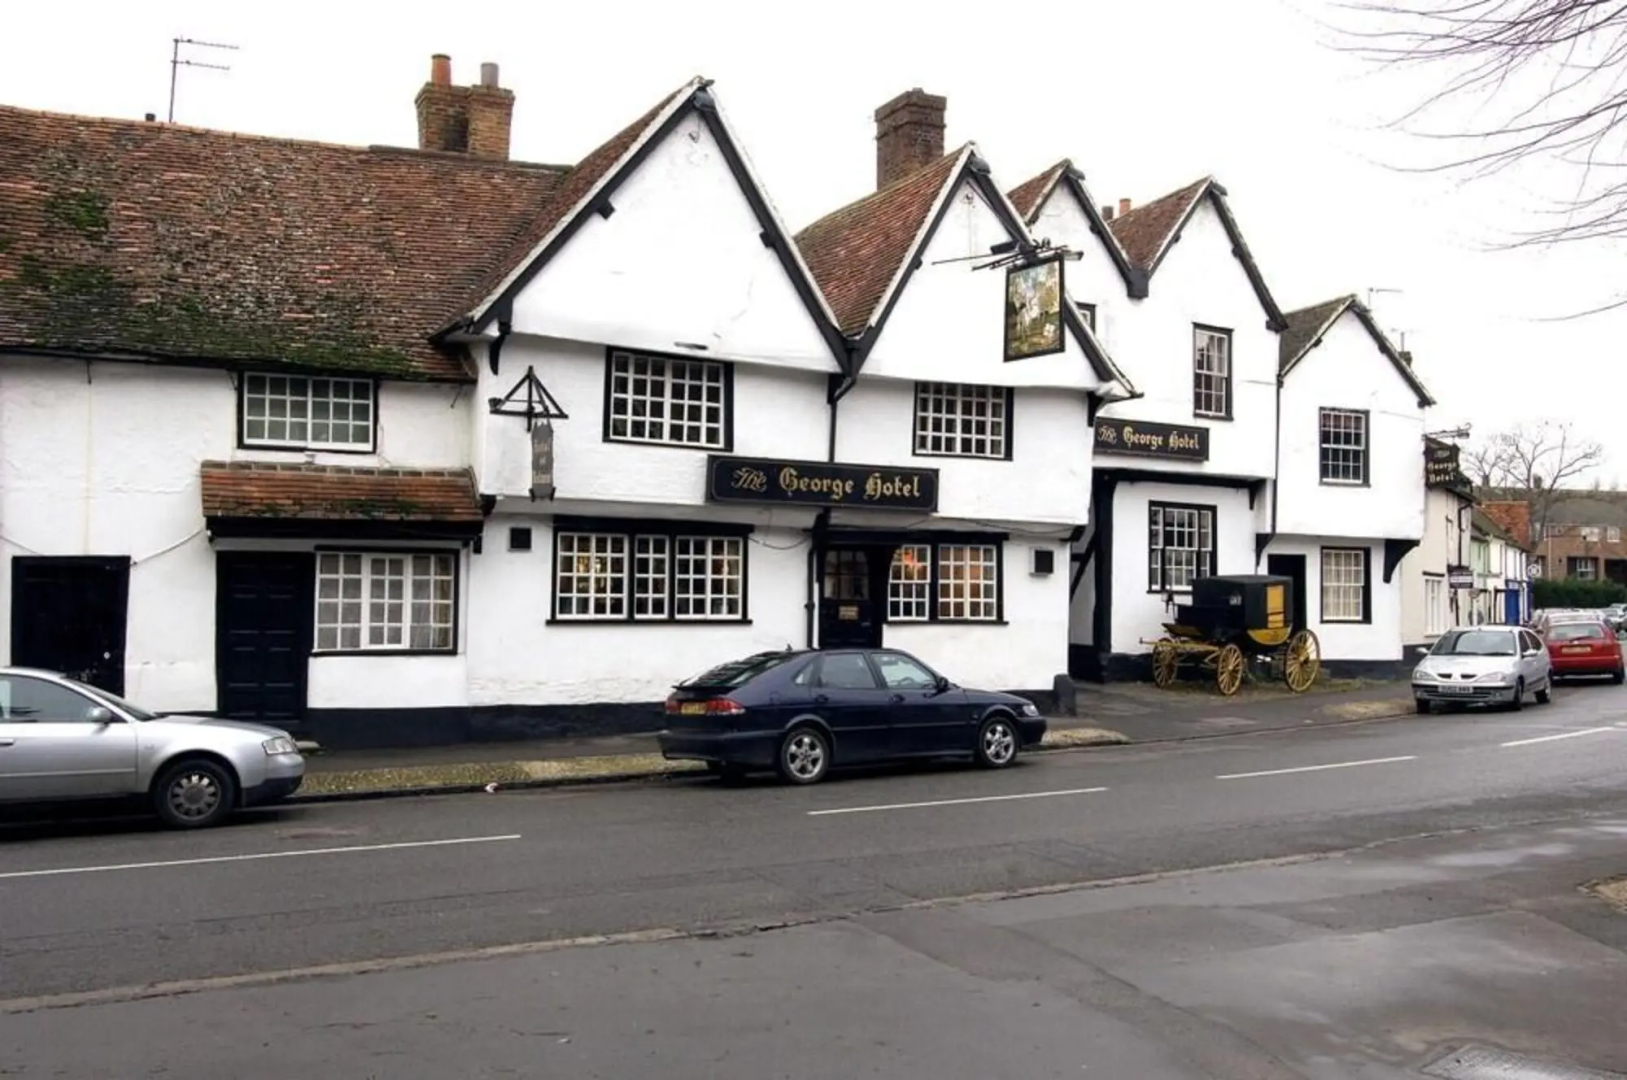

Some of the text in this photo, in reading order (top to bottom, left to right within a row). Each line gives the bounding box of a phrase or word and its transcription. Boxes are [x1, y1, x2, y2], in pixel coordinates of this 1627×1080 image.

[1122, 426, 1164, 450] George
[1168, 430, 1200, 451] Hotel
[731, 467, 921, 500] The George Hotel
